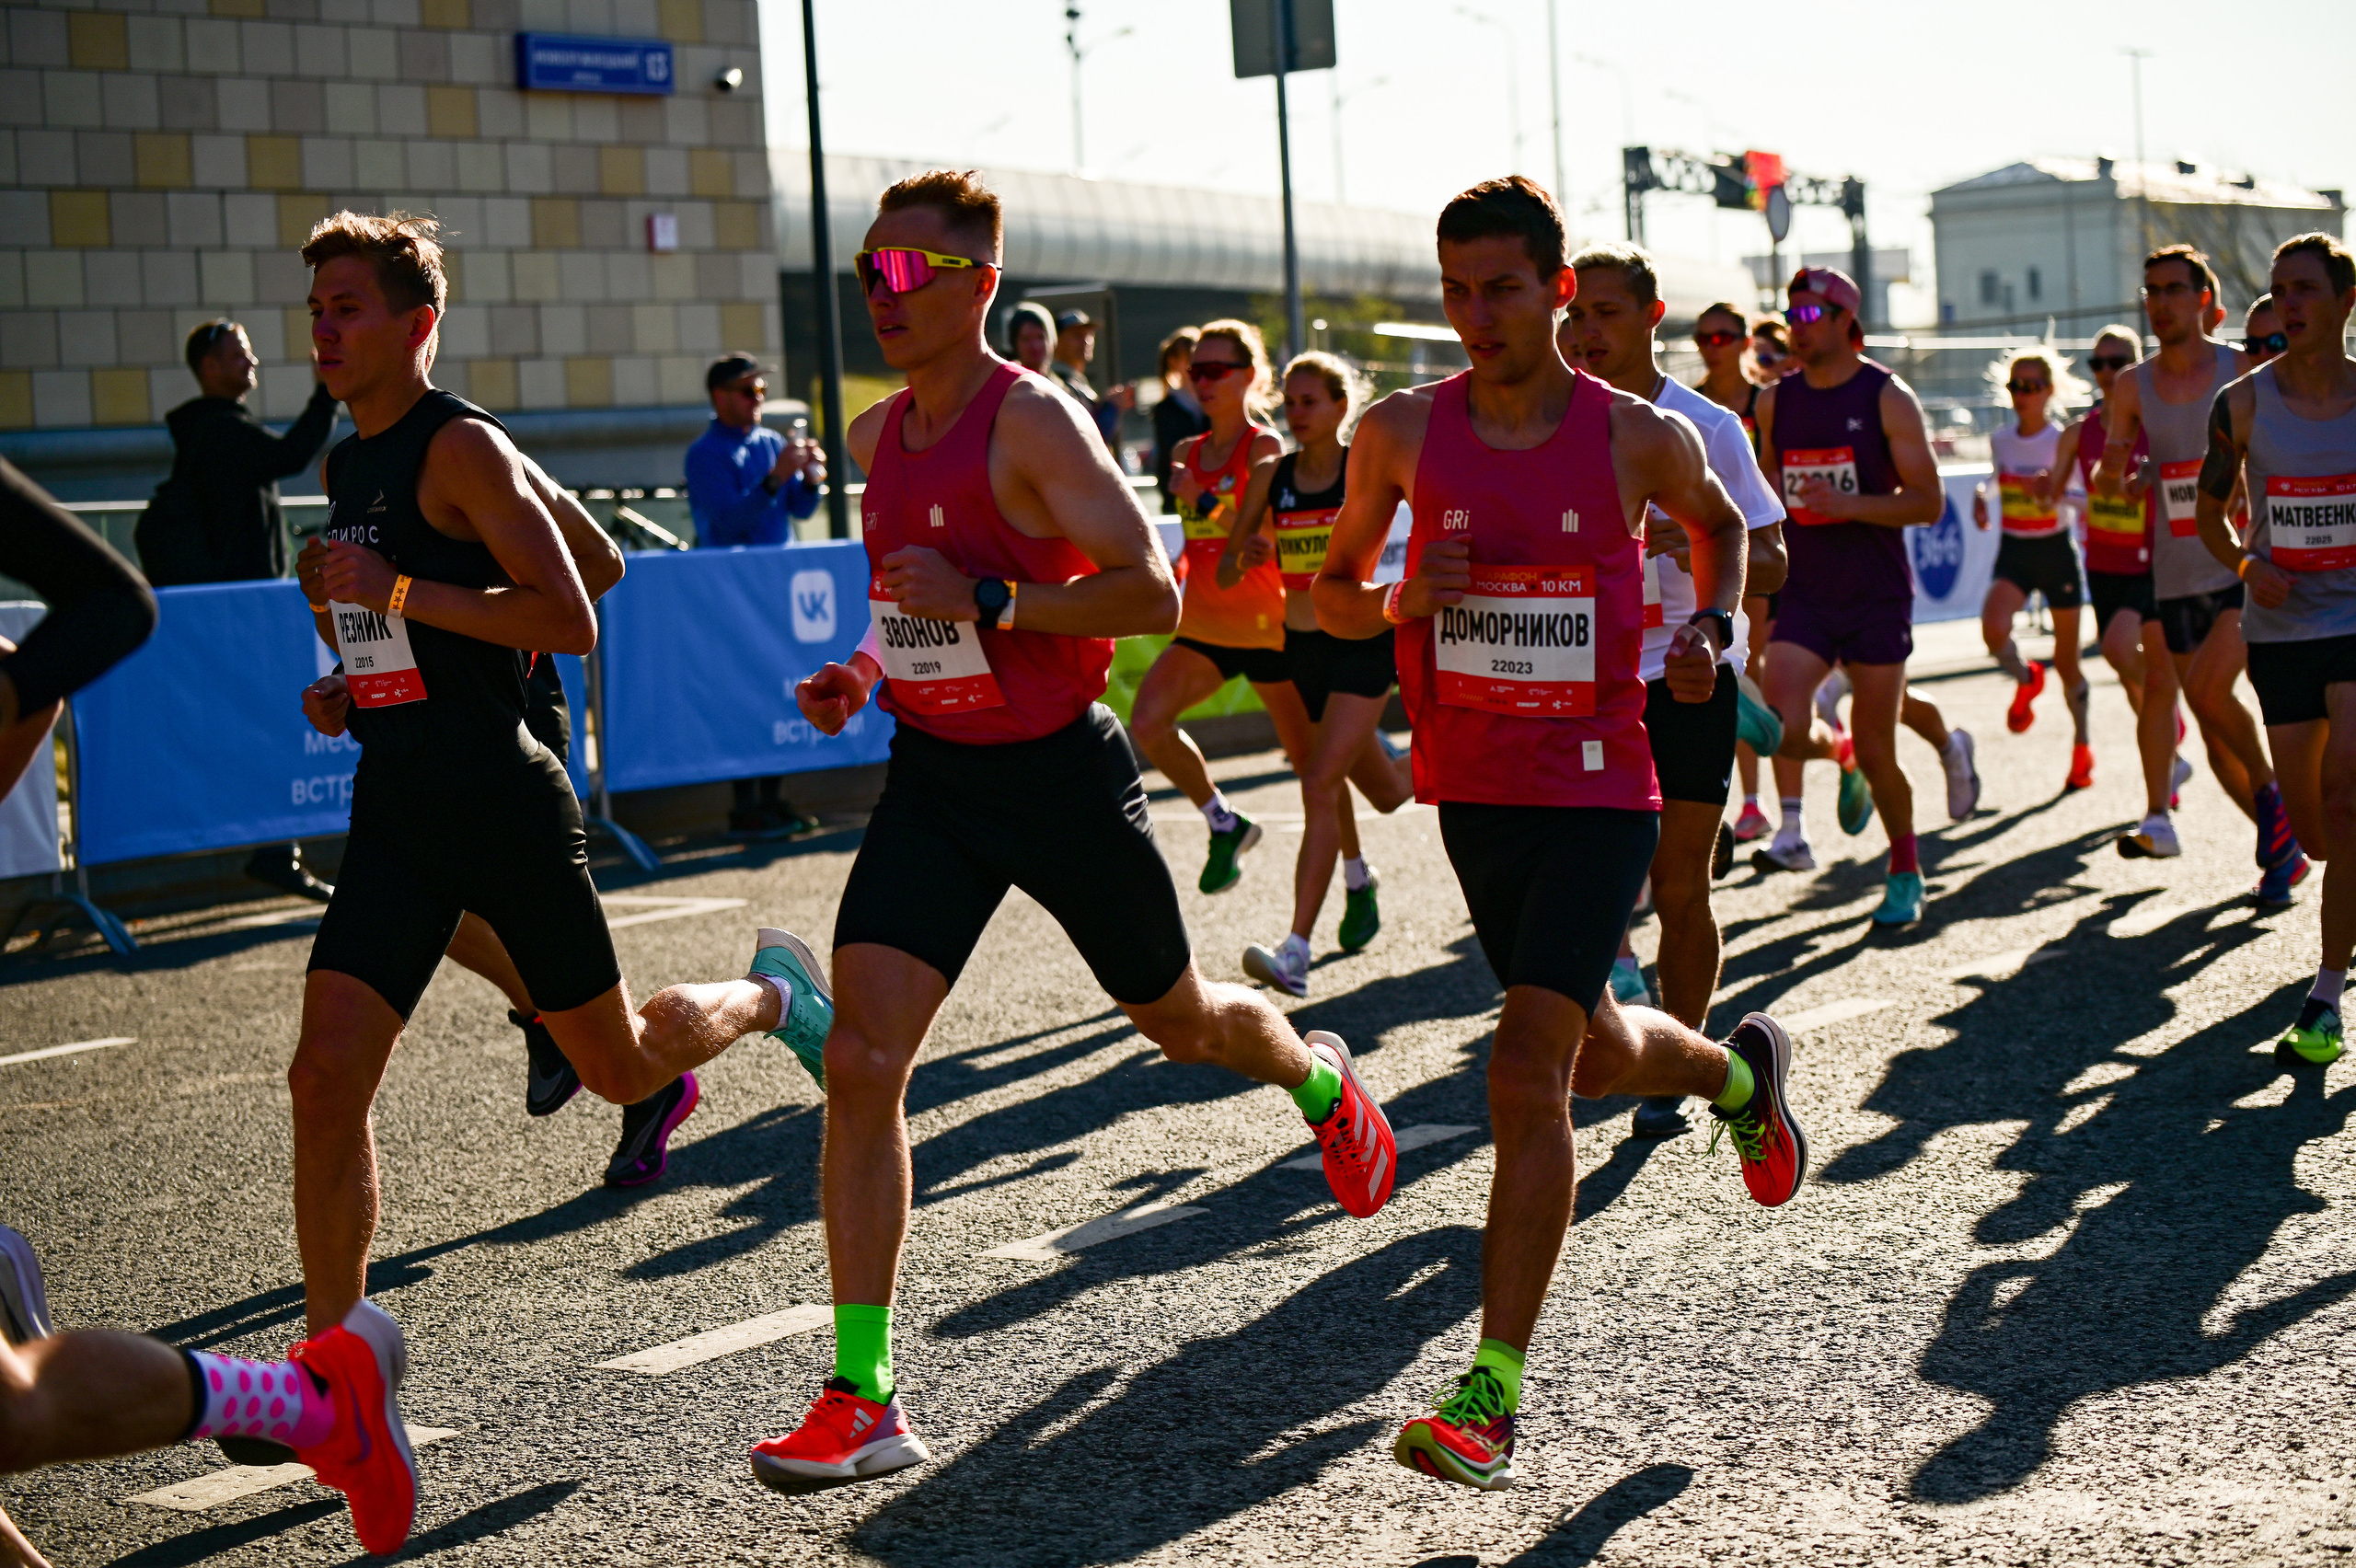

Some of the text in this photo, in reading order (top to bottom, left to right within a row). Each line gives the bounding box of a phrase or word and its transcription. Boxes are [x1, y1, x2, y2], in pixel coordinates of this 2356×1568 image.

[1443, 510, 1470, 530] GRi
[2272, 503, 2356, 527] МАТВЕЕНК
[1476, 580, 1581, 593] МОСКВА 10 КМ
[339, 611, 394, 643] РЕЗНИК
[881, 616, 961, 649] ЗВОНОВ
[1440, 606, 1590, 648] ДОМОРНИКОВ
[354, 656, 375, 669] 22015
[911, 661, 941, 674] 22019
[1491, 659, 1533, 674] 22023
